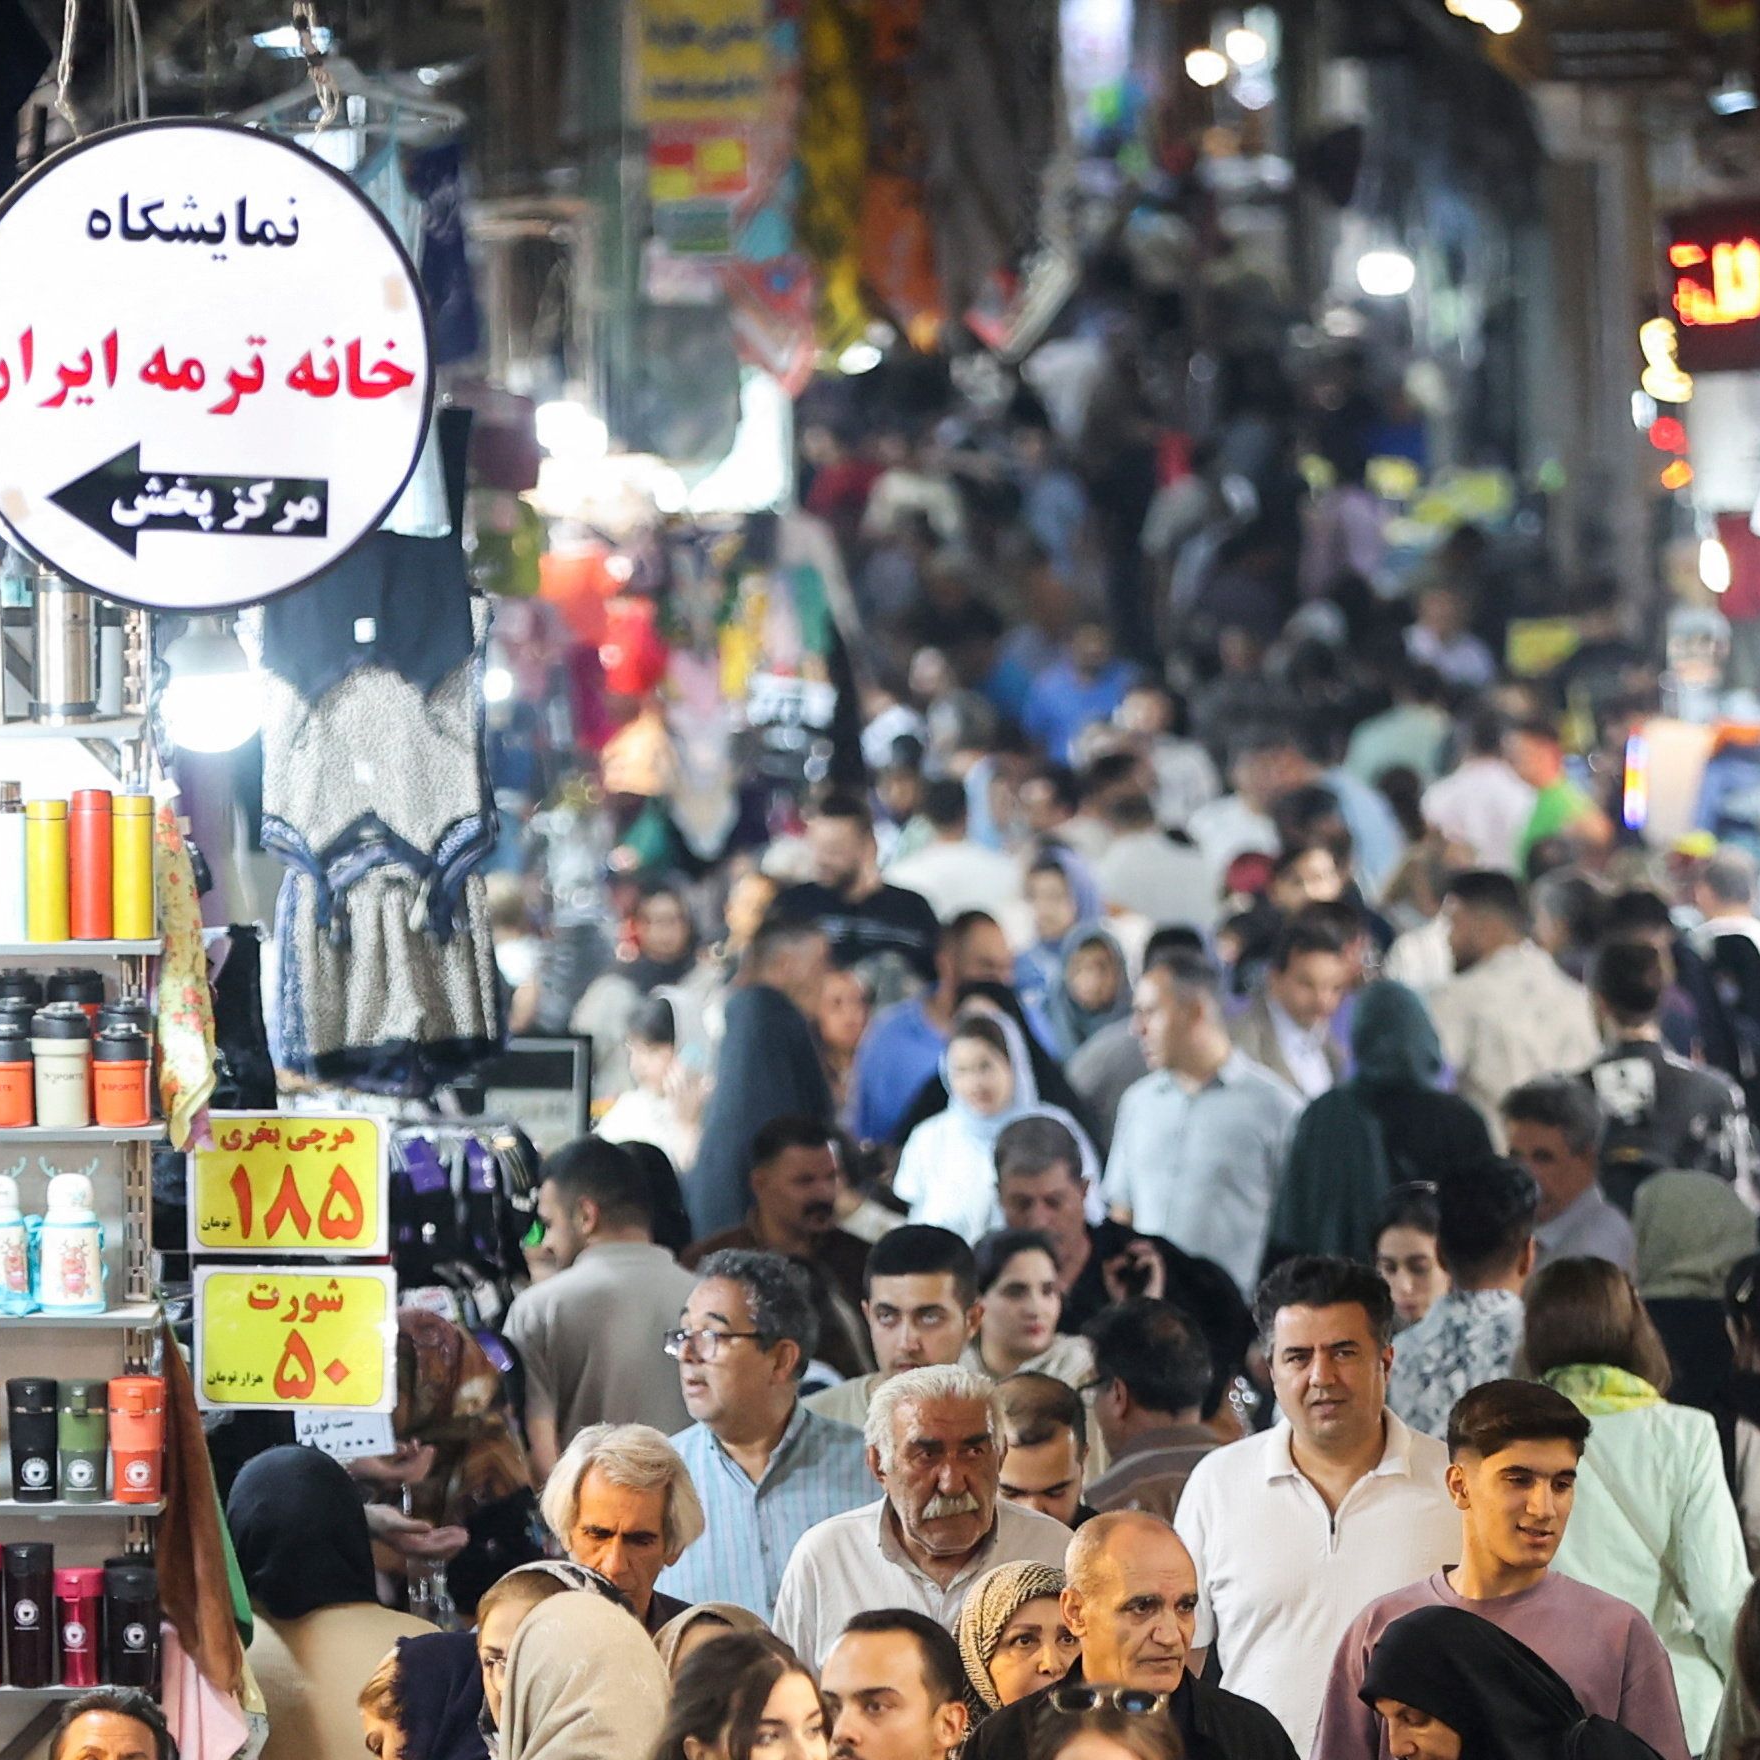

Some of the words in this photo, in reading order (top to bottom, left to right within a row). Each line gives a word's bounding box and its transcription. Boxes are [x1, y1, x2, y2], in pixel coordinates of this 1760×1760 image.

[85, 192, 299, 262] نمایشگاه
[140, 335, 266, 415] ترمه
[285, 336, 416, 399] خانه
[111, 475, 215, 531] پخش
[222, 479, 321, 533] مرکز
[219, 1120, 281, 1152] بخری
[200, 1216, 232, 1231] تومان
[230, 1162, 364, 1241] ۱۸۵
[247, 1279, 345, 1324] شورت
[206, 1370, 237, 1386] تومان
[240, 1371, 264, 1386] هزار
[273, 1328, 352, 1400] ۵۰
